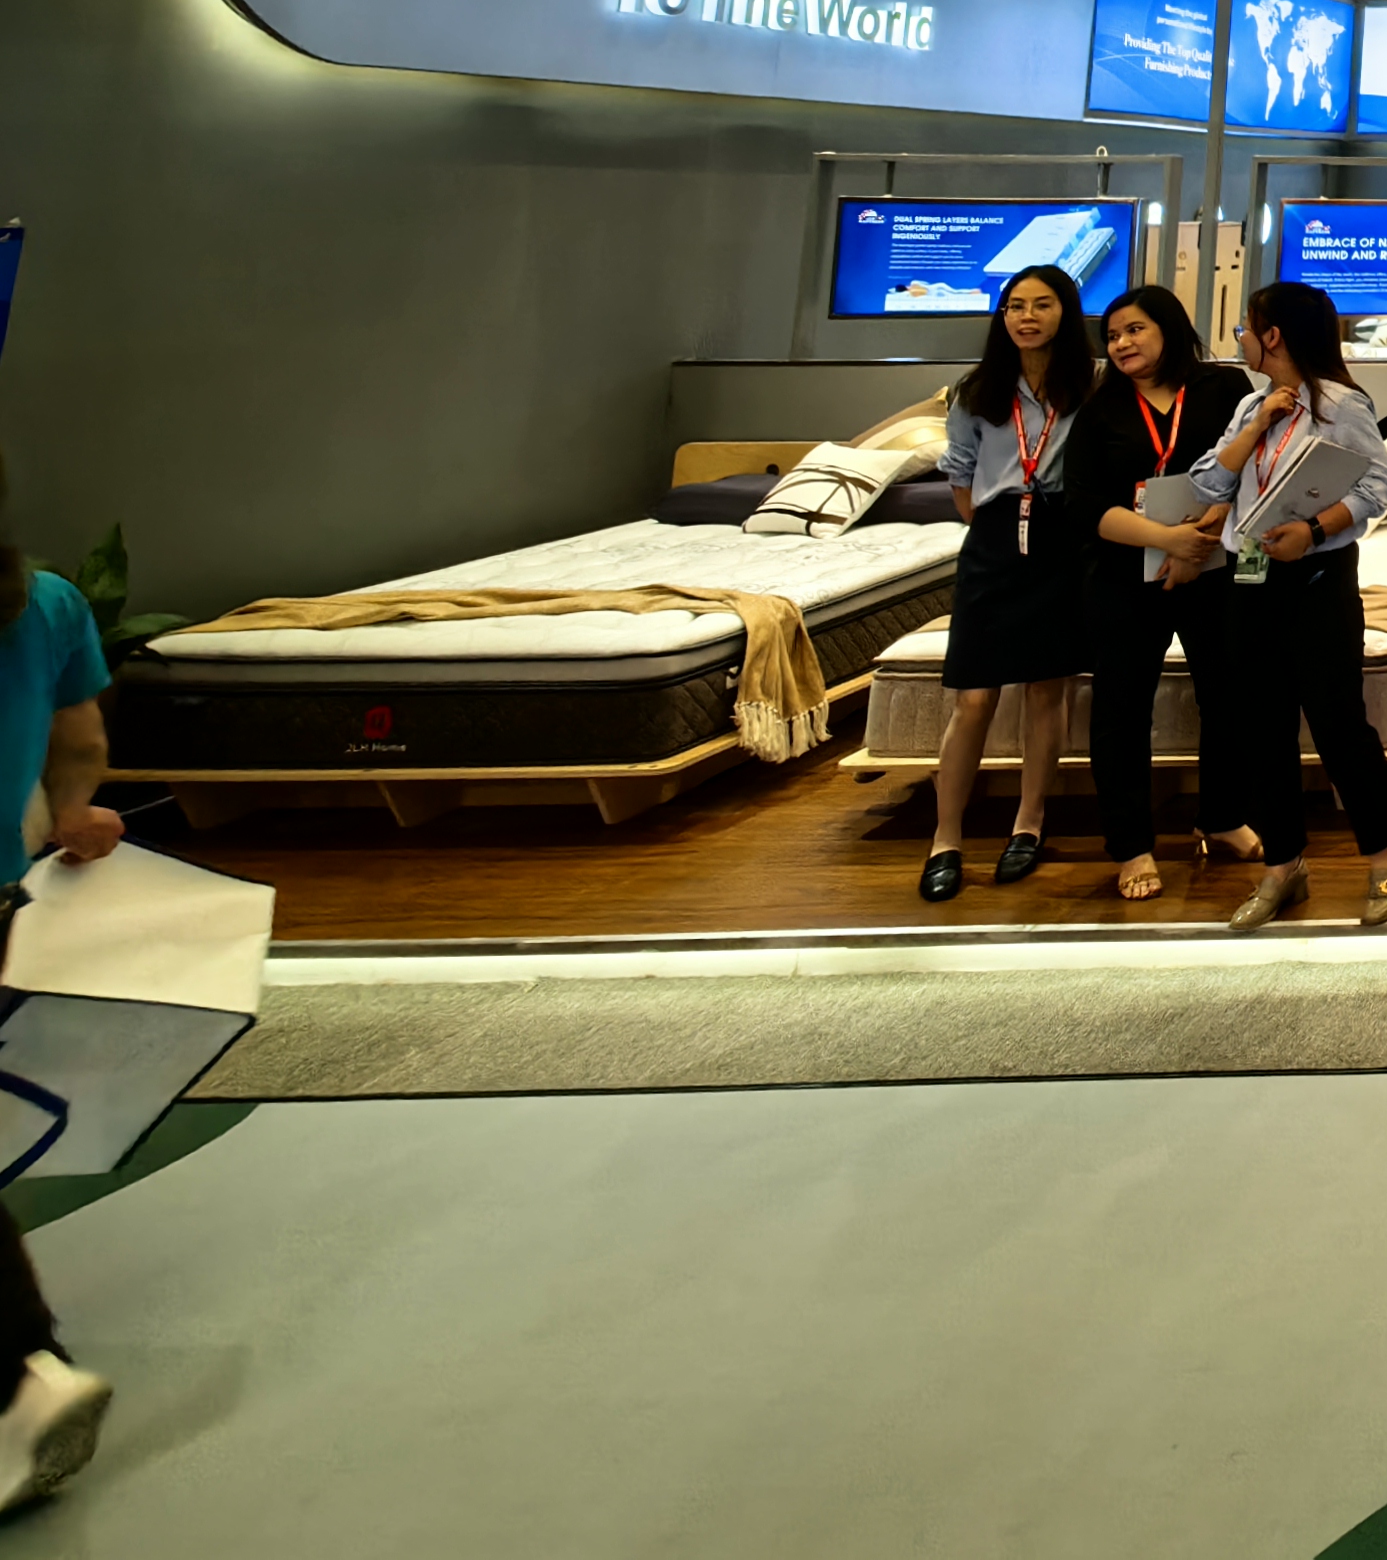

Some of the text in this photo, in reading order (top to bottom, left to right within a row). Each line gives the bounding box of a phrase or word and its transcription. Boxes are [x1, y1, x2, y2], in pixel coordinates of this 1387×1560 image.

[930, 224, 948, 232] AND
[1302, 237, 1357, 248] EMBRACE
[1359, 237, 1376, 248] OF
[1301, 249, 1349, 261] UNWIND
[1351, 249, 1377, 261] AND
